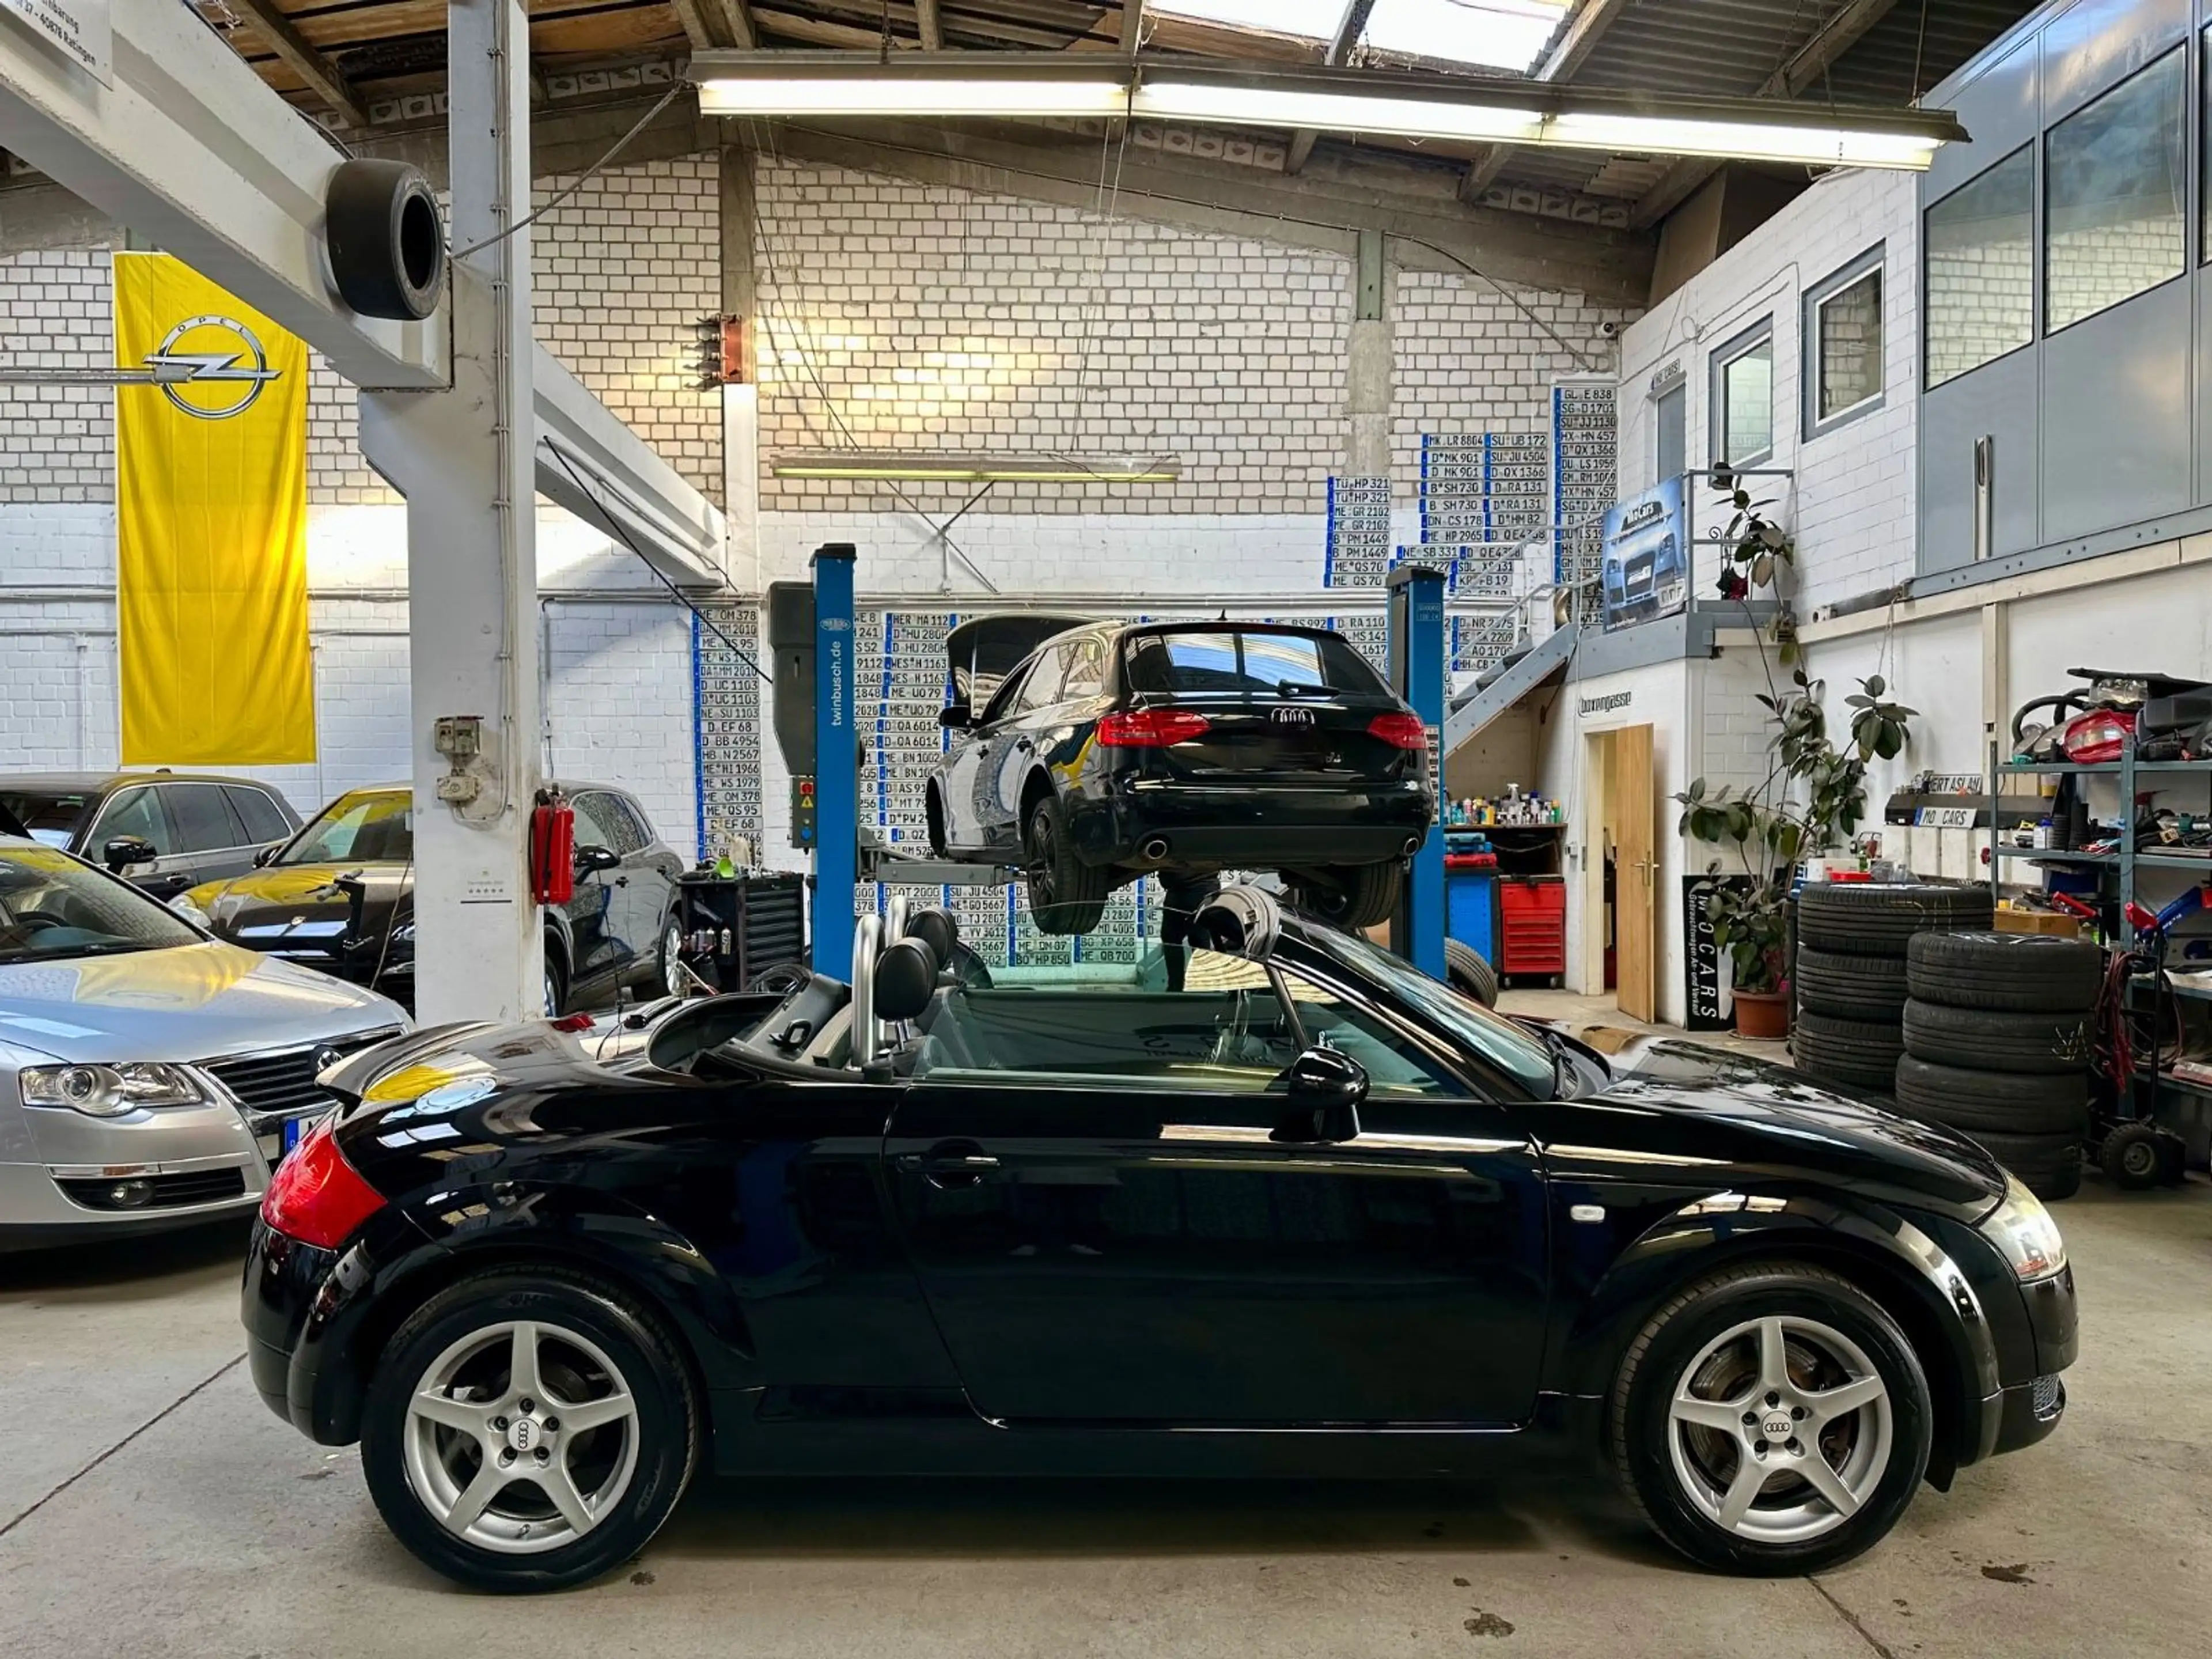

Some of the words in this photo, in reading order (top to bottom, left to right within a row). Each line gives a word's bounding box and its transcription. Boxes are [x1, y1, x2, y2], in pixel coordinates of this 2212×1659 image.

[177, 317, 244, 334] OPEL
[1565, 390, 1578, 399] GL
[1585, 390, 1590, 399] E
[1593, 390, 1612, 399] 838
[1562, 404, 1574, 412] SG
[1590, 404, 1614, 412] 1701
[1597, 431, 1615, 440] 457
[1590, 446, 1615, 454] 1366
[1432, 453, 1438, 463] D
[1460, 453, 1478, 463] 901
[1432, 468, 1438, 477] D
[1460, 468, 1478, 477] 901
[1492, 468, 1498, 477] D
[1520, 468, 1545, 477] 1366
[1354, 478, 1368, 488] HP
[1370, 478, 1388, 488] 321
[1431, 483, 1437, 493] B
[1445, 483, 1457, 493] SH
[1460, 483, 1478, 493] 730
[1508, 483, 1521, 493] RA
[1524, 483, 1541, 493] 131
[1354, 492, 1368, 502] HP
[1370, 492, 1388, 502] 321
[1430, 501, 1435, 510] B
[1443, 501, 1457, 510] SH
[1459, 501, 1477, 510] 730
[1507, 500, 1520, 509] RA
[1523, 500, 1540, 509] 131
[1528, 514, 1539, 524] 82
[1334, 535, 1340, 544] B
[1348, 535, 1361, 544] PM
[1363, 535, 1388, 544] 1449
[1460, 531, 1482, 540] 2965
[1333, 548, 1339, 558] B
[1347, 548, 1359, 558] PM
[1362, 548, 1387, 558] 1449
[1424, 548, 1435, 556] SB
[1440, 548, 1457, 556] 331
[1335, 562, 1348, 571] ME
[1370, 562, 1383, 571] 70
[1334, 576, 1347, 585] ME
[1369, 576, 1382, 585] 70
[737, 610, 756, 620] 378
[893, 615, 910, 624] HER
[931, 615, 948, 624] 112
[1350, 618, 1363, 628] RA
[1366, 618, 1385, 628] 110
[893, 643, 899, 653] D
[906, 643, 919, 653] HU
[701, 680, 707, 690] D
[732, 680, 757, 690] 1103
[831, 641, 841, 726] twinbusch.de
[892, 687, 906, 698] ME
[929, 687, 941, 698] 79
[702, 695, 708, 704] D
[732, 695, 758, 704] 1103
[721, 709, 732, 718] SU
[736, 709, 758, 718] 1103
[708, 722, 714, 732] D
[722, 722, 736, 732] EF
[738, 722, 751, 732] 68
[885, 720, 891, 730] D
[914, 720, 938, 730] 6014
[702, 736, 709, 746] D
[716, 736, 729, 746] BB
[733, 736, 759, 746] 4954
[885, 736, 891, 746] D
[913, 736, 938, 746] 6014
[724, 750, 730, 759] N
[733, 750, 759, 759] 2567
[703, 764, 716, 774] ME
[736, 764, 759, 774] 1966
[737, 778, 760, 787] 1979
[704, 792, 717, 801] ME
[741, 792, 760, 801] 378
[706, 806, 720, 815] ME
[744, 806, 757, 815] 95
[1942, 810, 1967, 825] CARS
[982, 900, 1005, 910] 5667
[1115, 952, 1134, 961] 700
